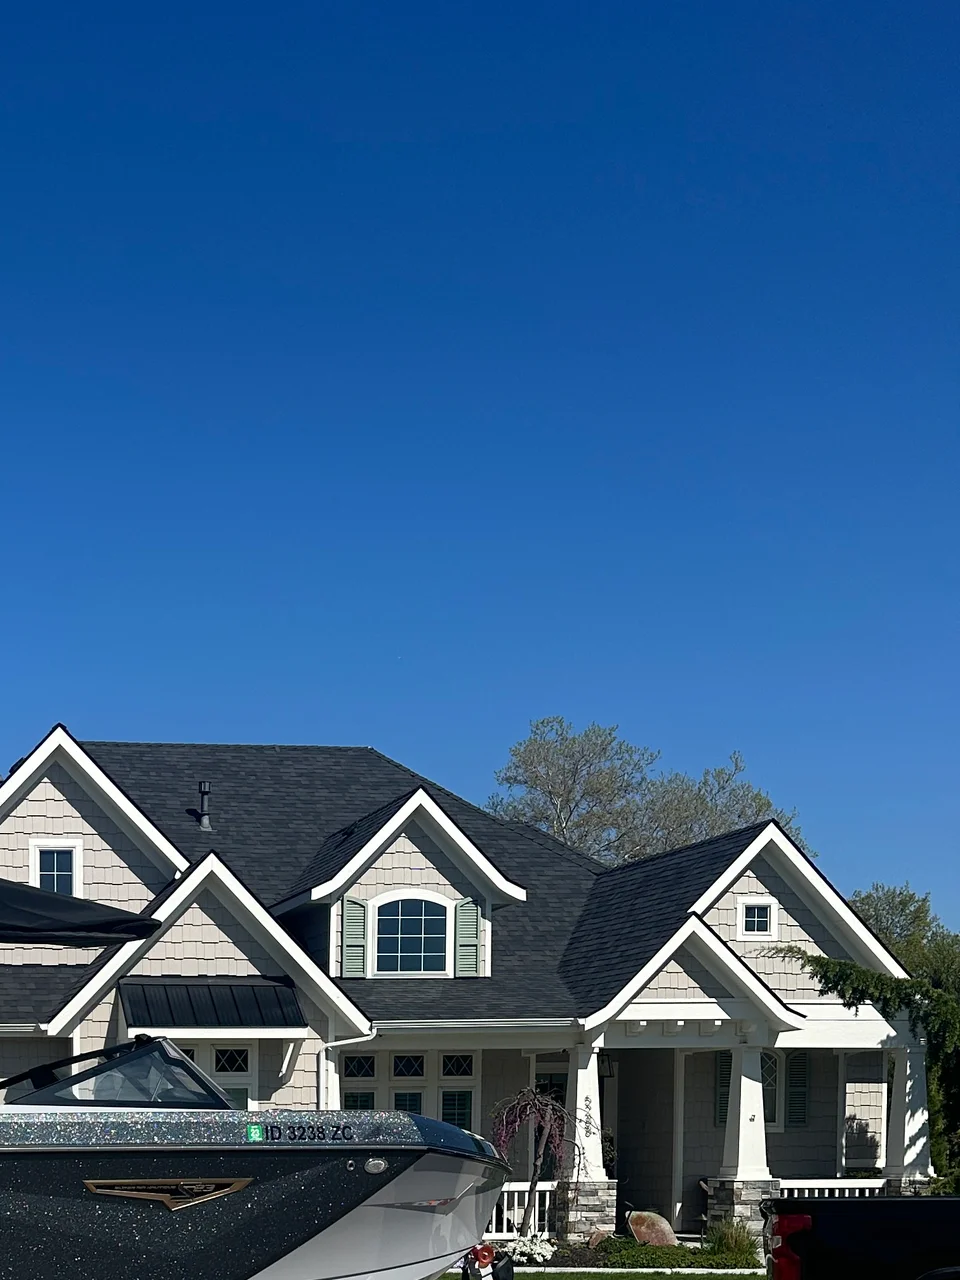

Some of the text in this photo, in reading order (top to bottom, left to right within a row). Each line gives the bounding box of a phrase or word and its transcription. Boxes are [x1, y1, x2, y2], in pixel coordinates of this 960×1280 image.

[265, 1126, 354, 1140] ID 3238 ZC
